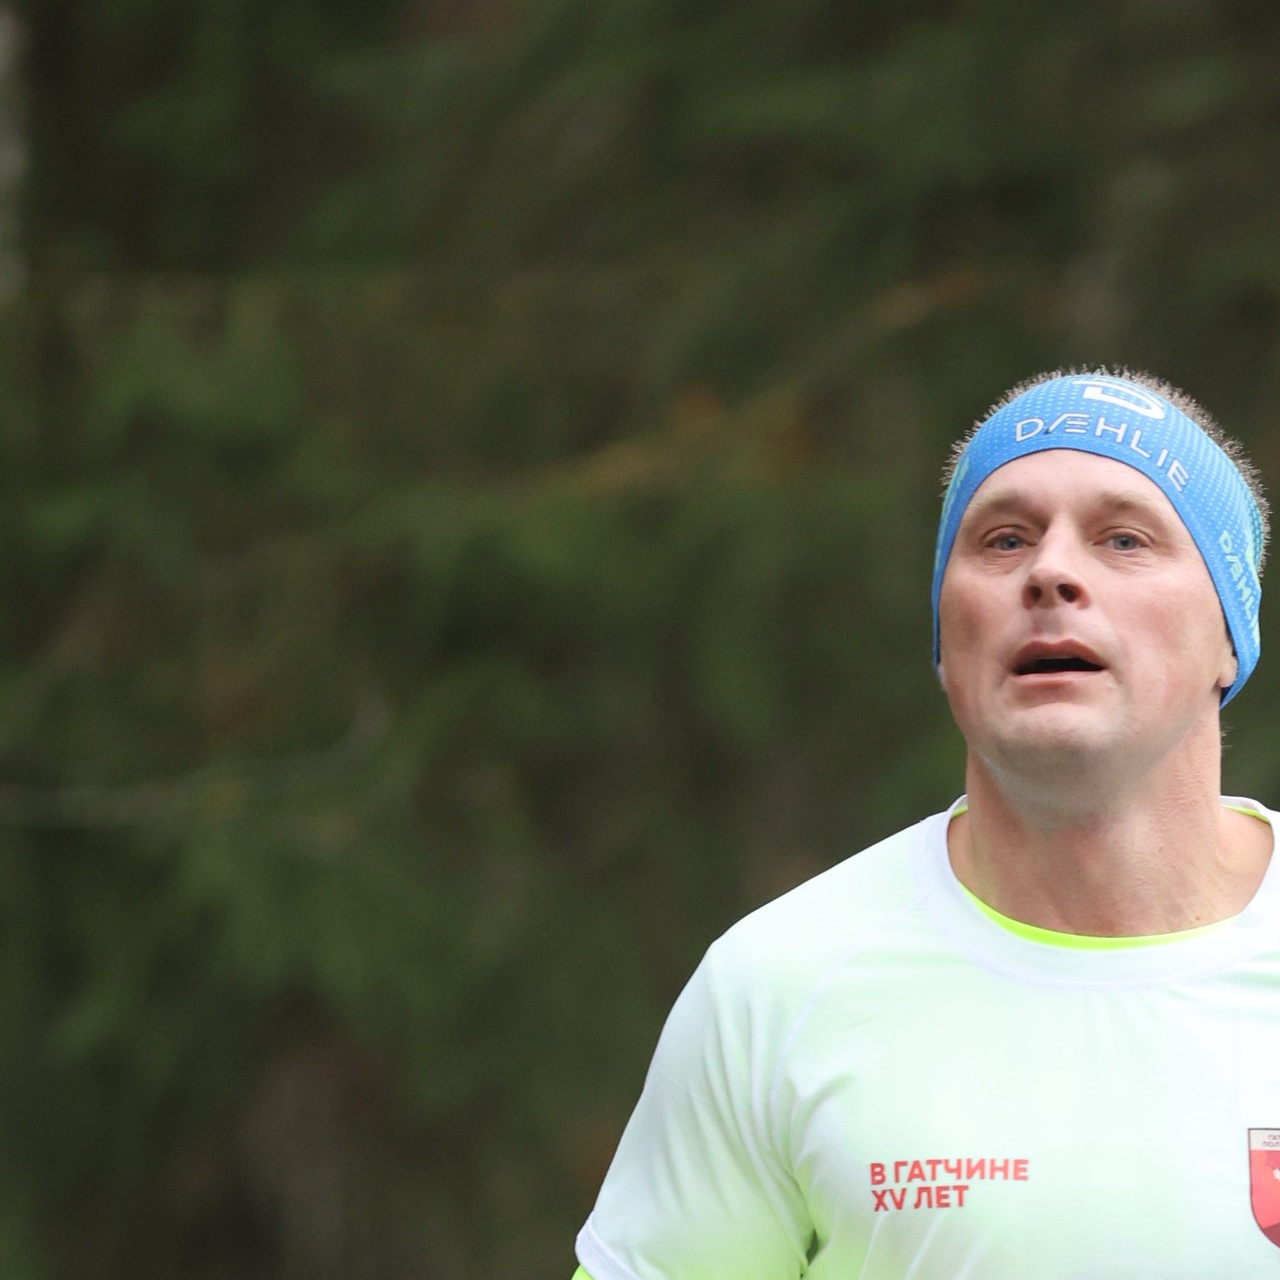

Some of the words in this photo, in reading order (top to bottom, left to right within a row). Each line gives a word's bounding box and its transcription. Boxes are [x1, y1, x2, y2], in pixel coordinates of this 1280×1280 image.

[869, 1163, 886, 1185] В
[892, 1159, 1029, 1182] ГАТЧИНЕ
[872, 1188, 907, 1212] XV
[913, 1185, 970, 1209] ЛЕТ
